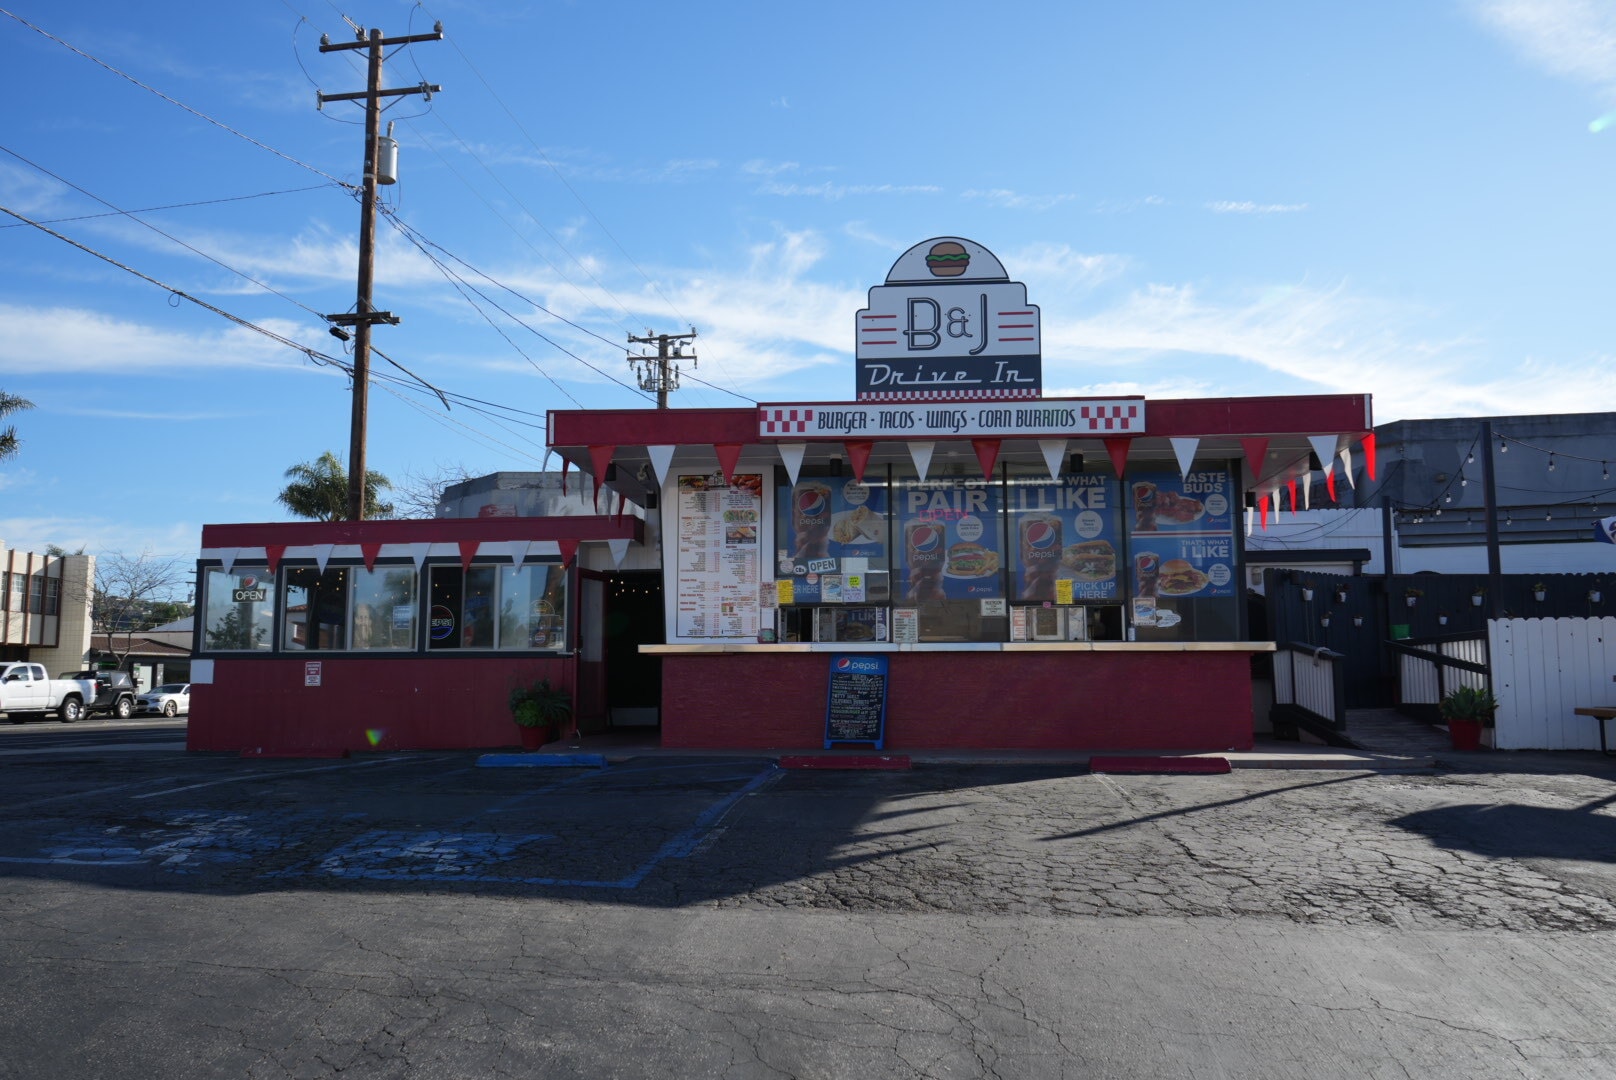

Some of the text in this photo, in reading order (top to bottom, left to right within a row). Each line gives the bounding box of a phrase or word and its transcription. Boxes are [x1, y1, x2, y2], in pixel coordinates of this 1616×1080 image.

[865, 361, 1035, 386] Drive In
[817, 408, 1076, 434] BURGER TACOS WINGS CORN BURRITOS
[1067, 475, 1106, 486] WHAT
[1183, 483, 1223, 493] BUDS
[908, 491, 989, 513] PAIR
[1019, 487, 1106, 510] I LIKE
[919, 508, 969, 522] OPEN
[799, 517, 824, 526] pepsi
[1028, 551, 1055, 559] pepsi
[1181, 546, 1230, 558] I LIKE
[912, 553, 938, 562] pepsi
[810, 559, 835, 571] OPEN
[803, 585, 819, 593] HERE
[1074, 582, 1115, 590] PICK UP
[235, 590, 264, 600] OPEN
[1079, 590, 1108, 599] HERE
[431, 618, 453, 627] EPSI
[851, 661, 879, 671] pepsi
